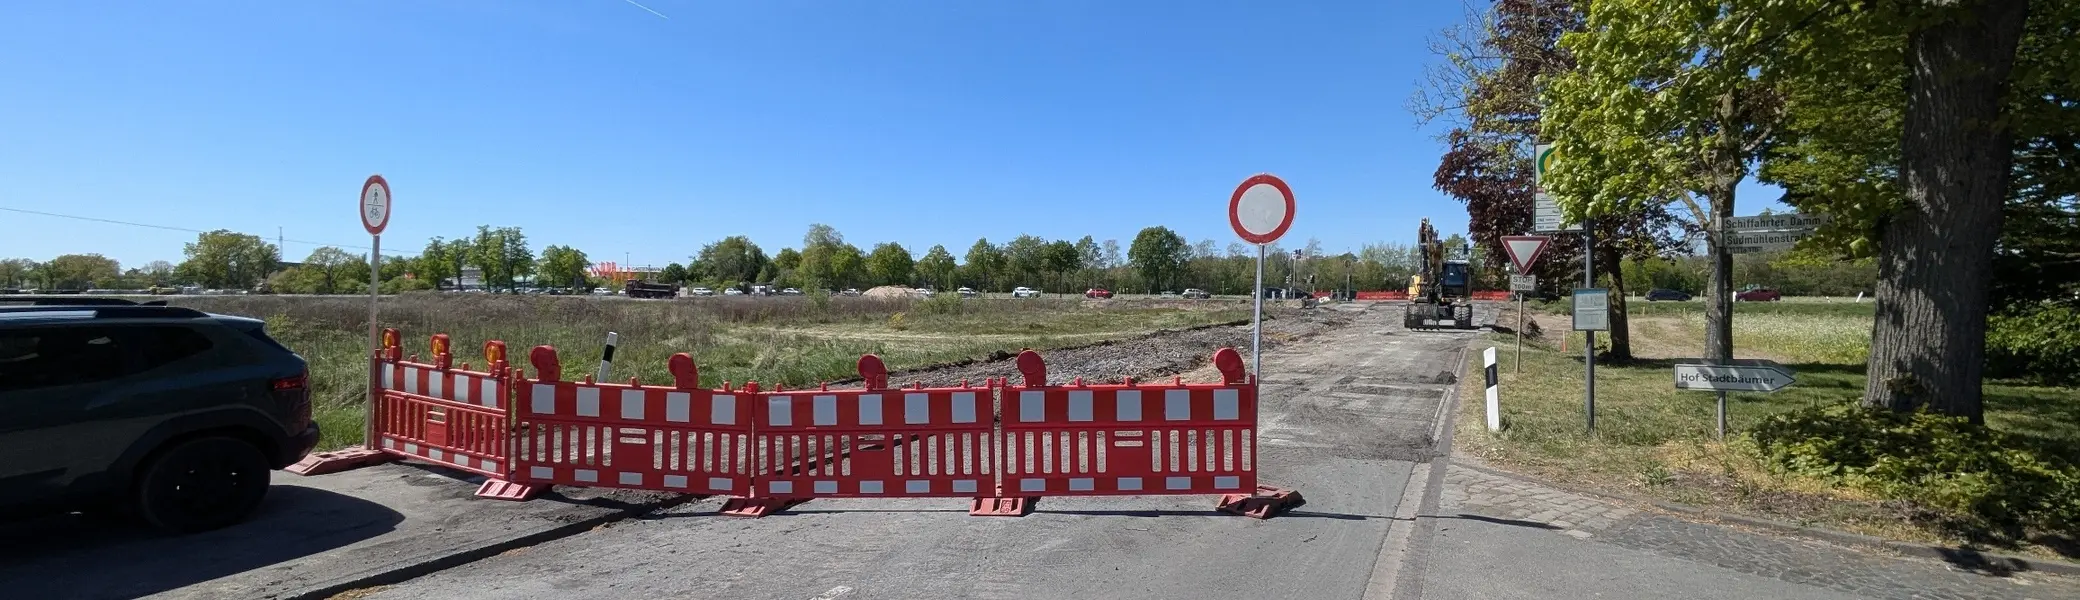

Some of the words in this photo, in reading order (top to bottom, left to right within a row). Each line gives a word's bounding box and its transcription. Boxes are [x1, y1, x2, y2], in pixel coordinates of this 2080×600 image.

[1726, 217, 1785, 229] Schiffahrter
[1790, 216, 1821, 226] Damm
[1681, 373, 1700, 381] Hof
[1702, 373, 1775, 385] Stadtbäumer
